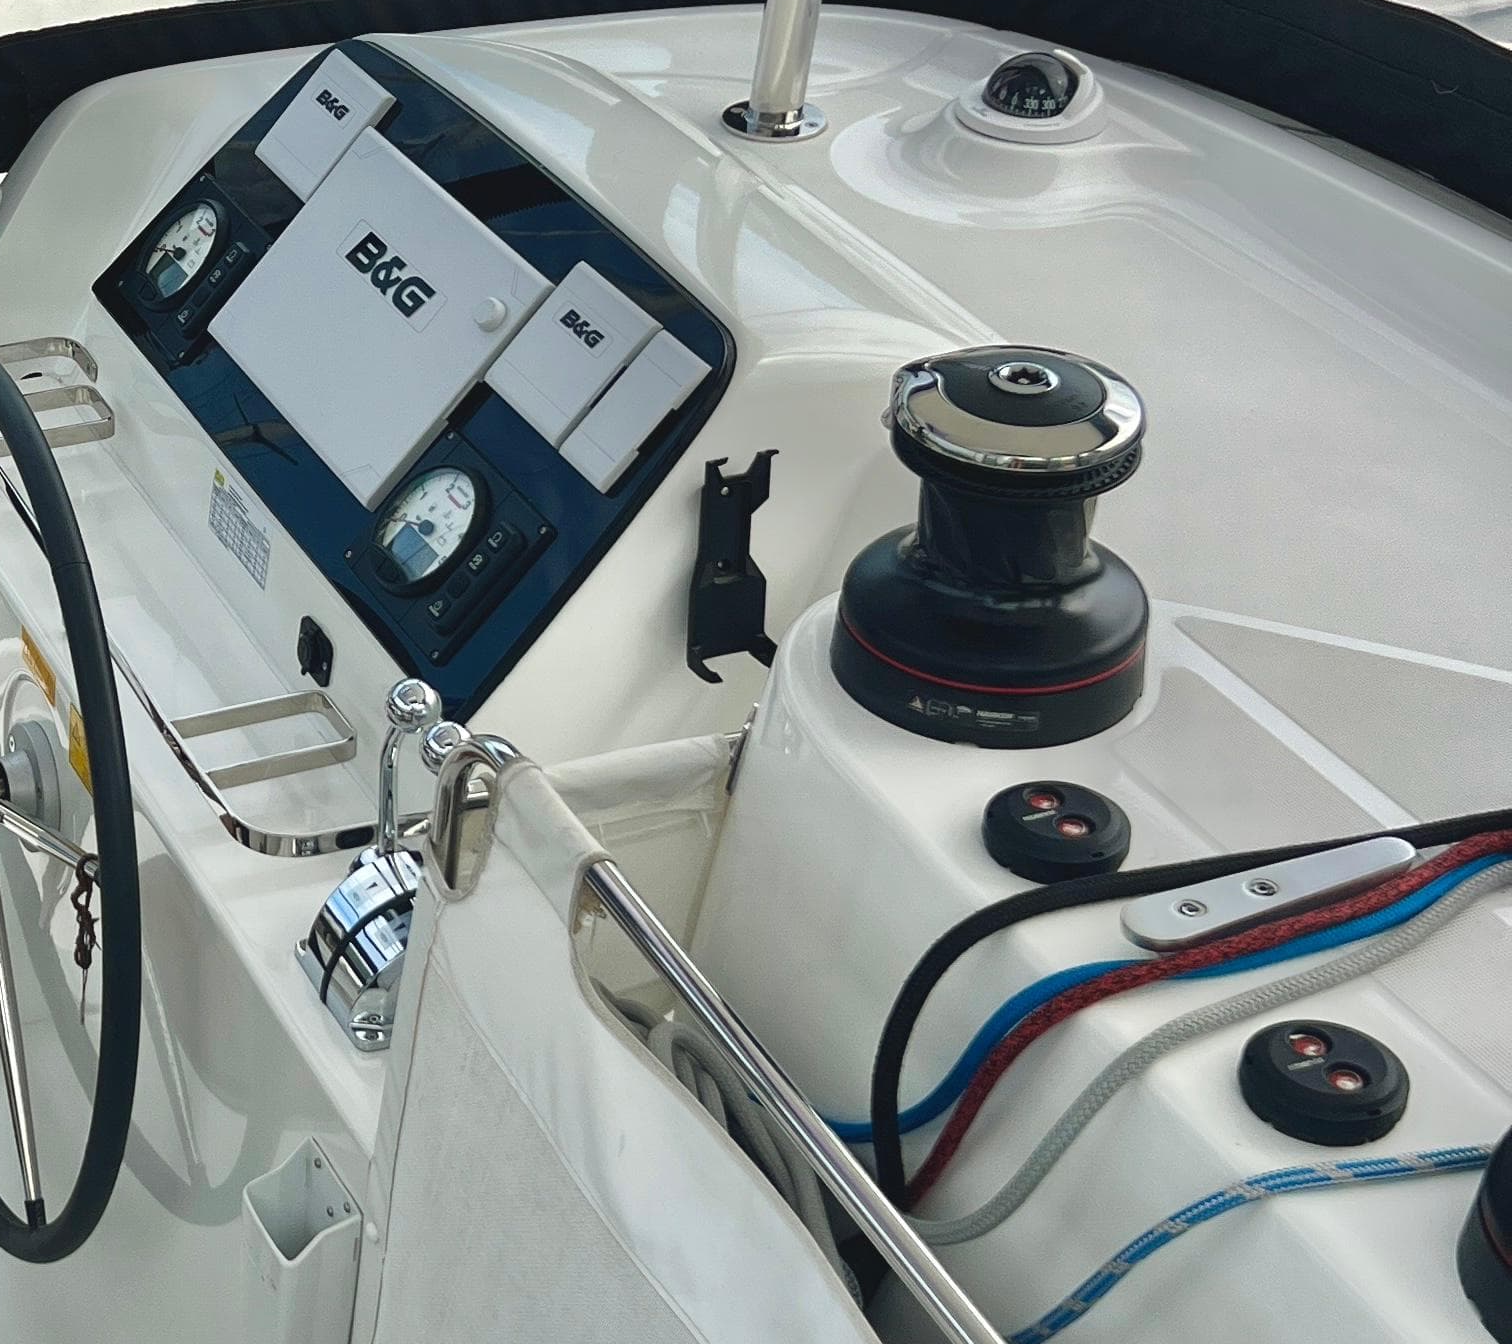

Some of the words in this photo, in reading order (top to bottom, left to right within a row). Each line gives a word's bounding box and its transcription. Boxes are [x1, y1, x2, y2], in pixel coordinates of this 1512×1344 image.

[316, 89, 349, 120] B&G
[345, 231, 436, 318] B&G
[559, 309, 605, 348] B&G
